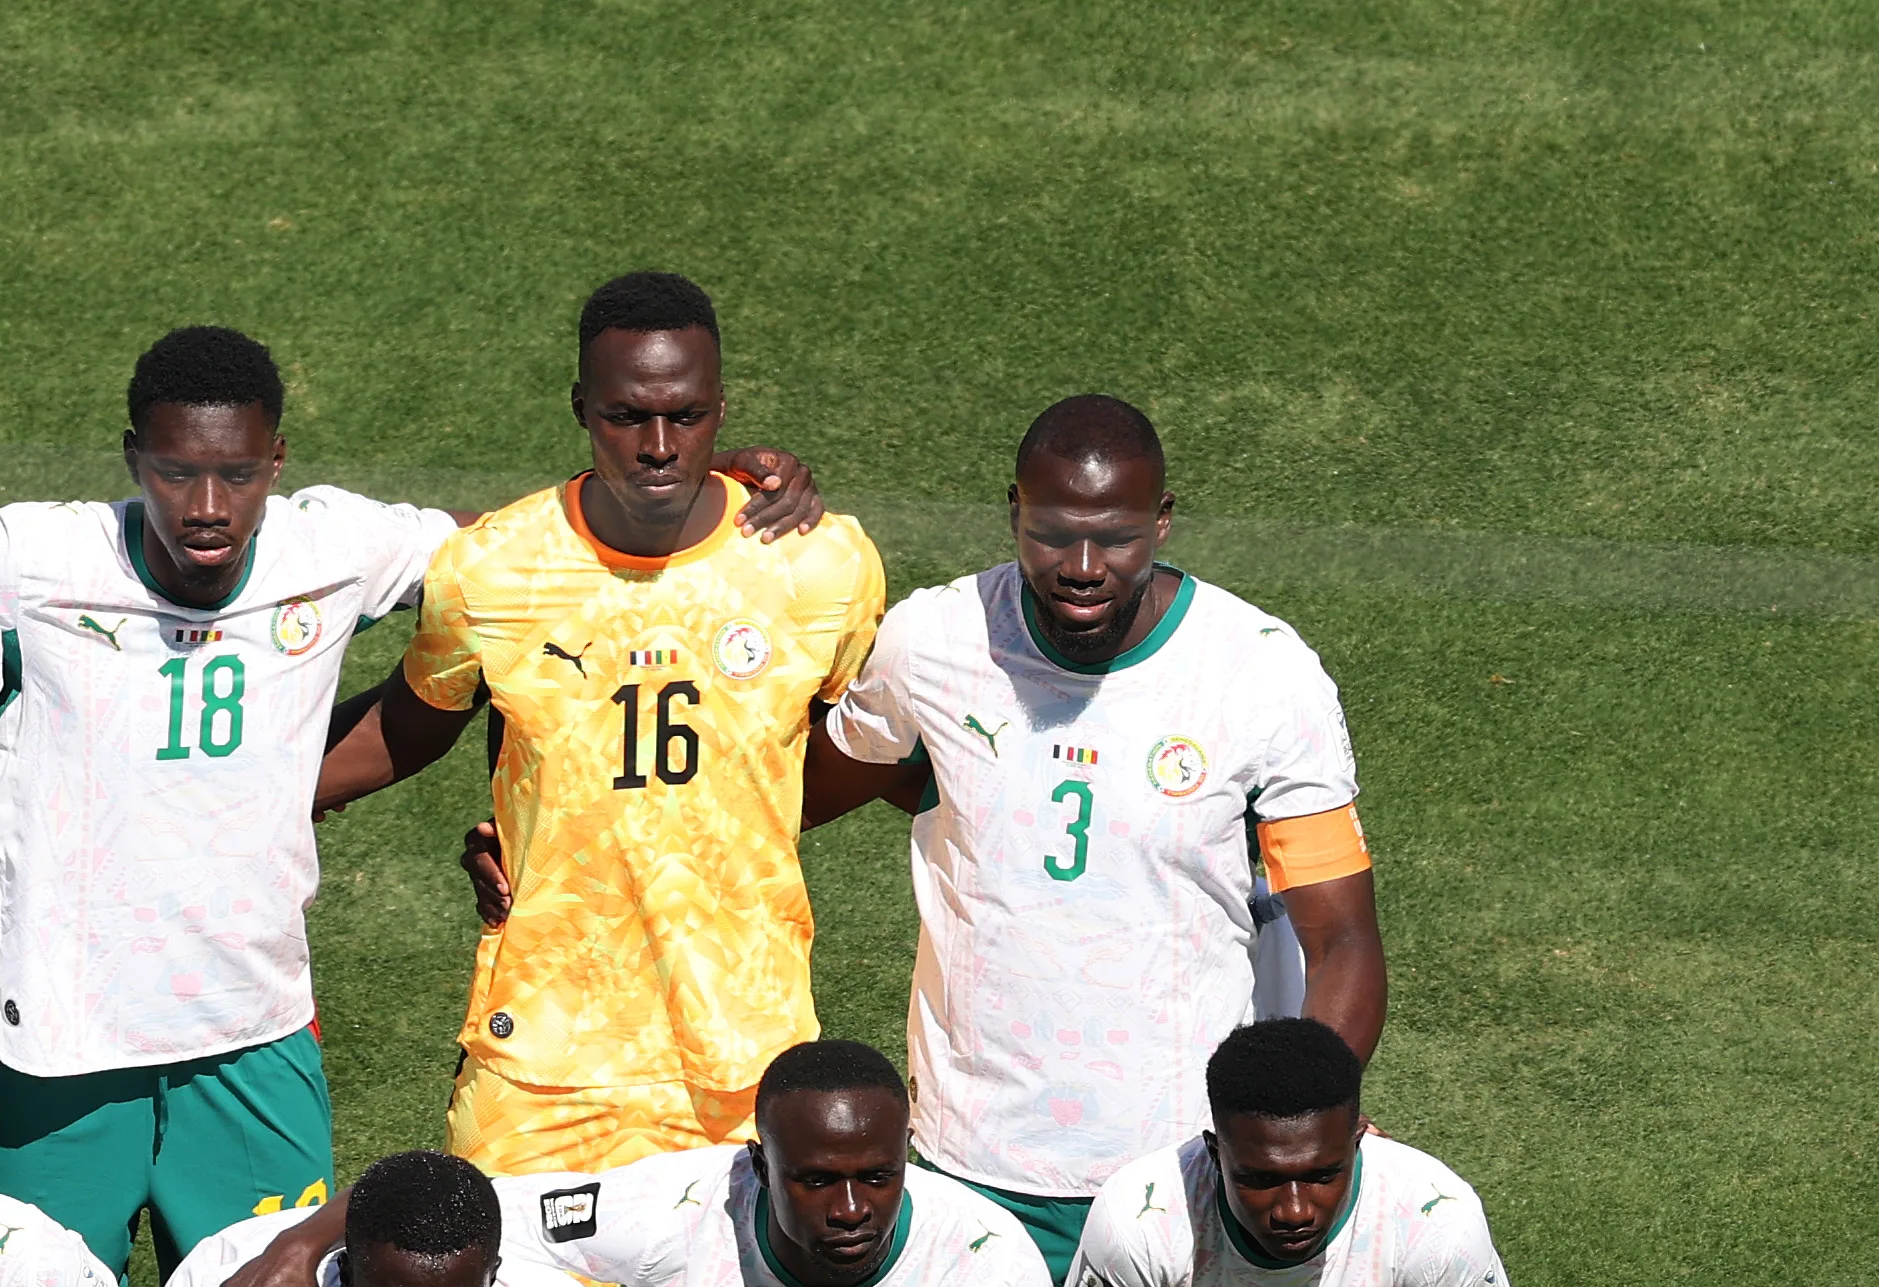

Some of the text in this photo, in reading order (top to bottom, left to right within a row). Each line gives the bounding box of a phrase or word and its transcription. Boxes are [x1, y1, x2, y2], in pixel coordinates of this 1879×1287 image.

[155, 654, 245, 760] 18
[610, 680, 700, 790] 16
[1043, 779, 1094, 882] 3
